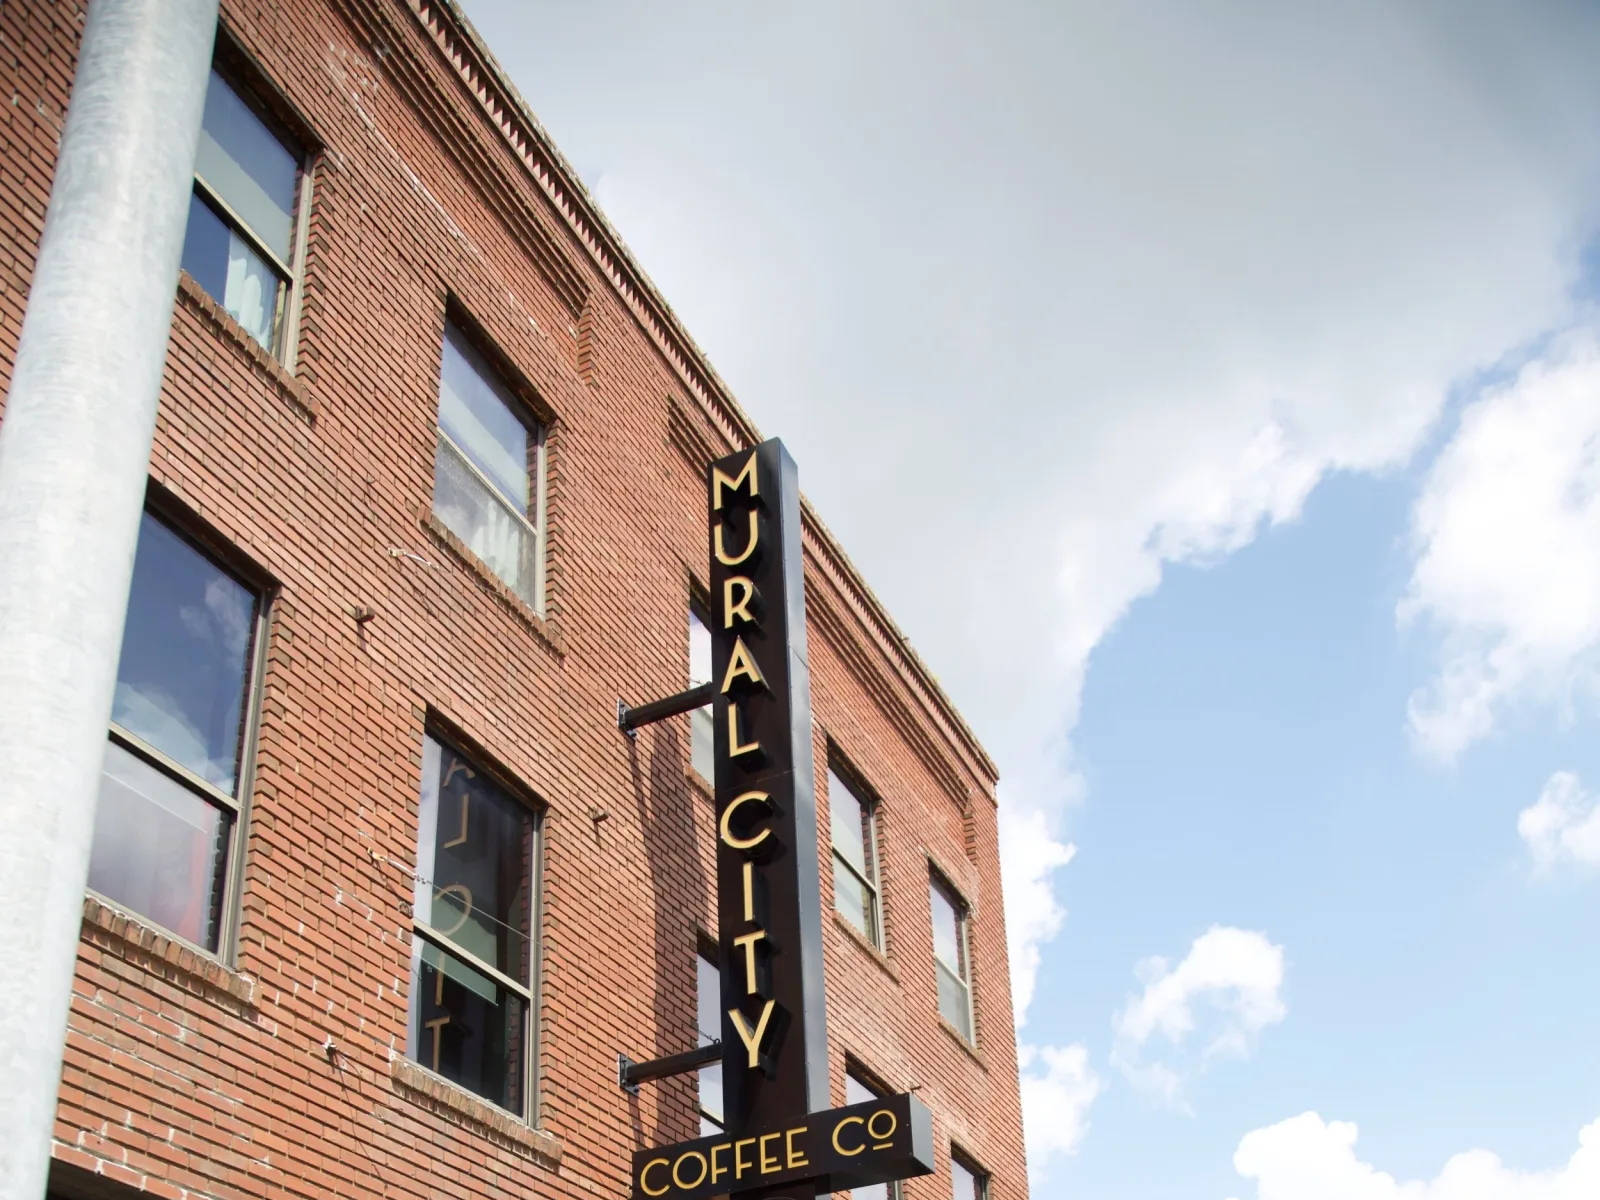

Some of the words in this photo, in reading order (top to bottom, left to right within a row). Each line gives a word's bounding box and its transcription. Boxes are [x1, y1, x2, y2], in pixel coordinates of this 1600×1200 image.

[713, 450, 761, 758] MURAL
[720, 791, 776, 1068] CITY
[640, 1127, 809, 1197] COFFEE
